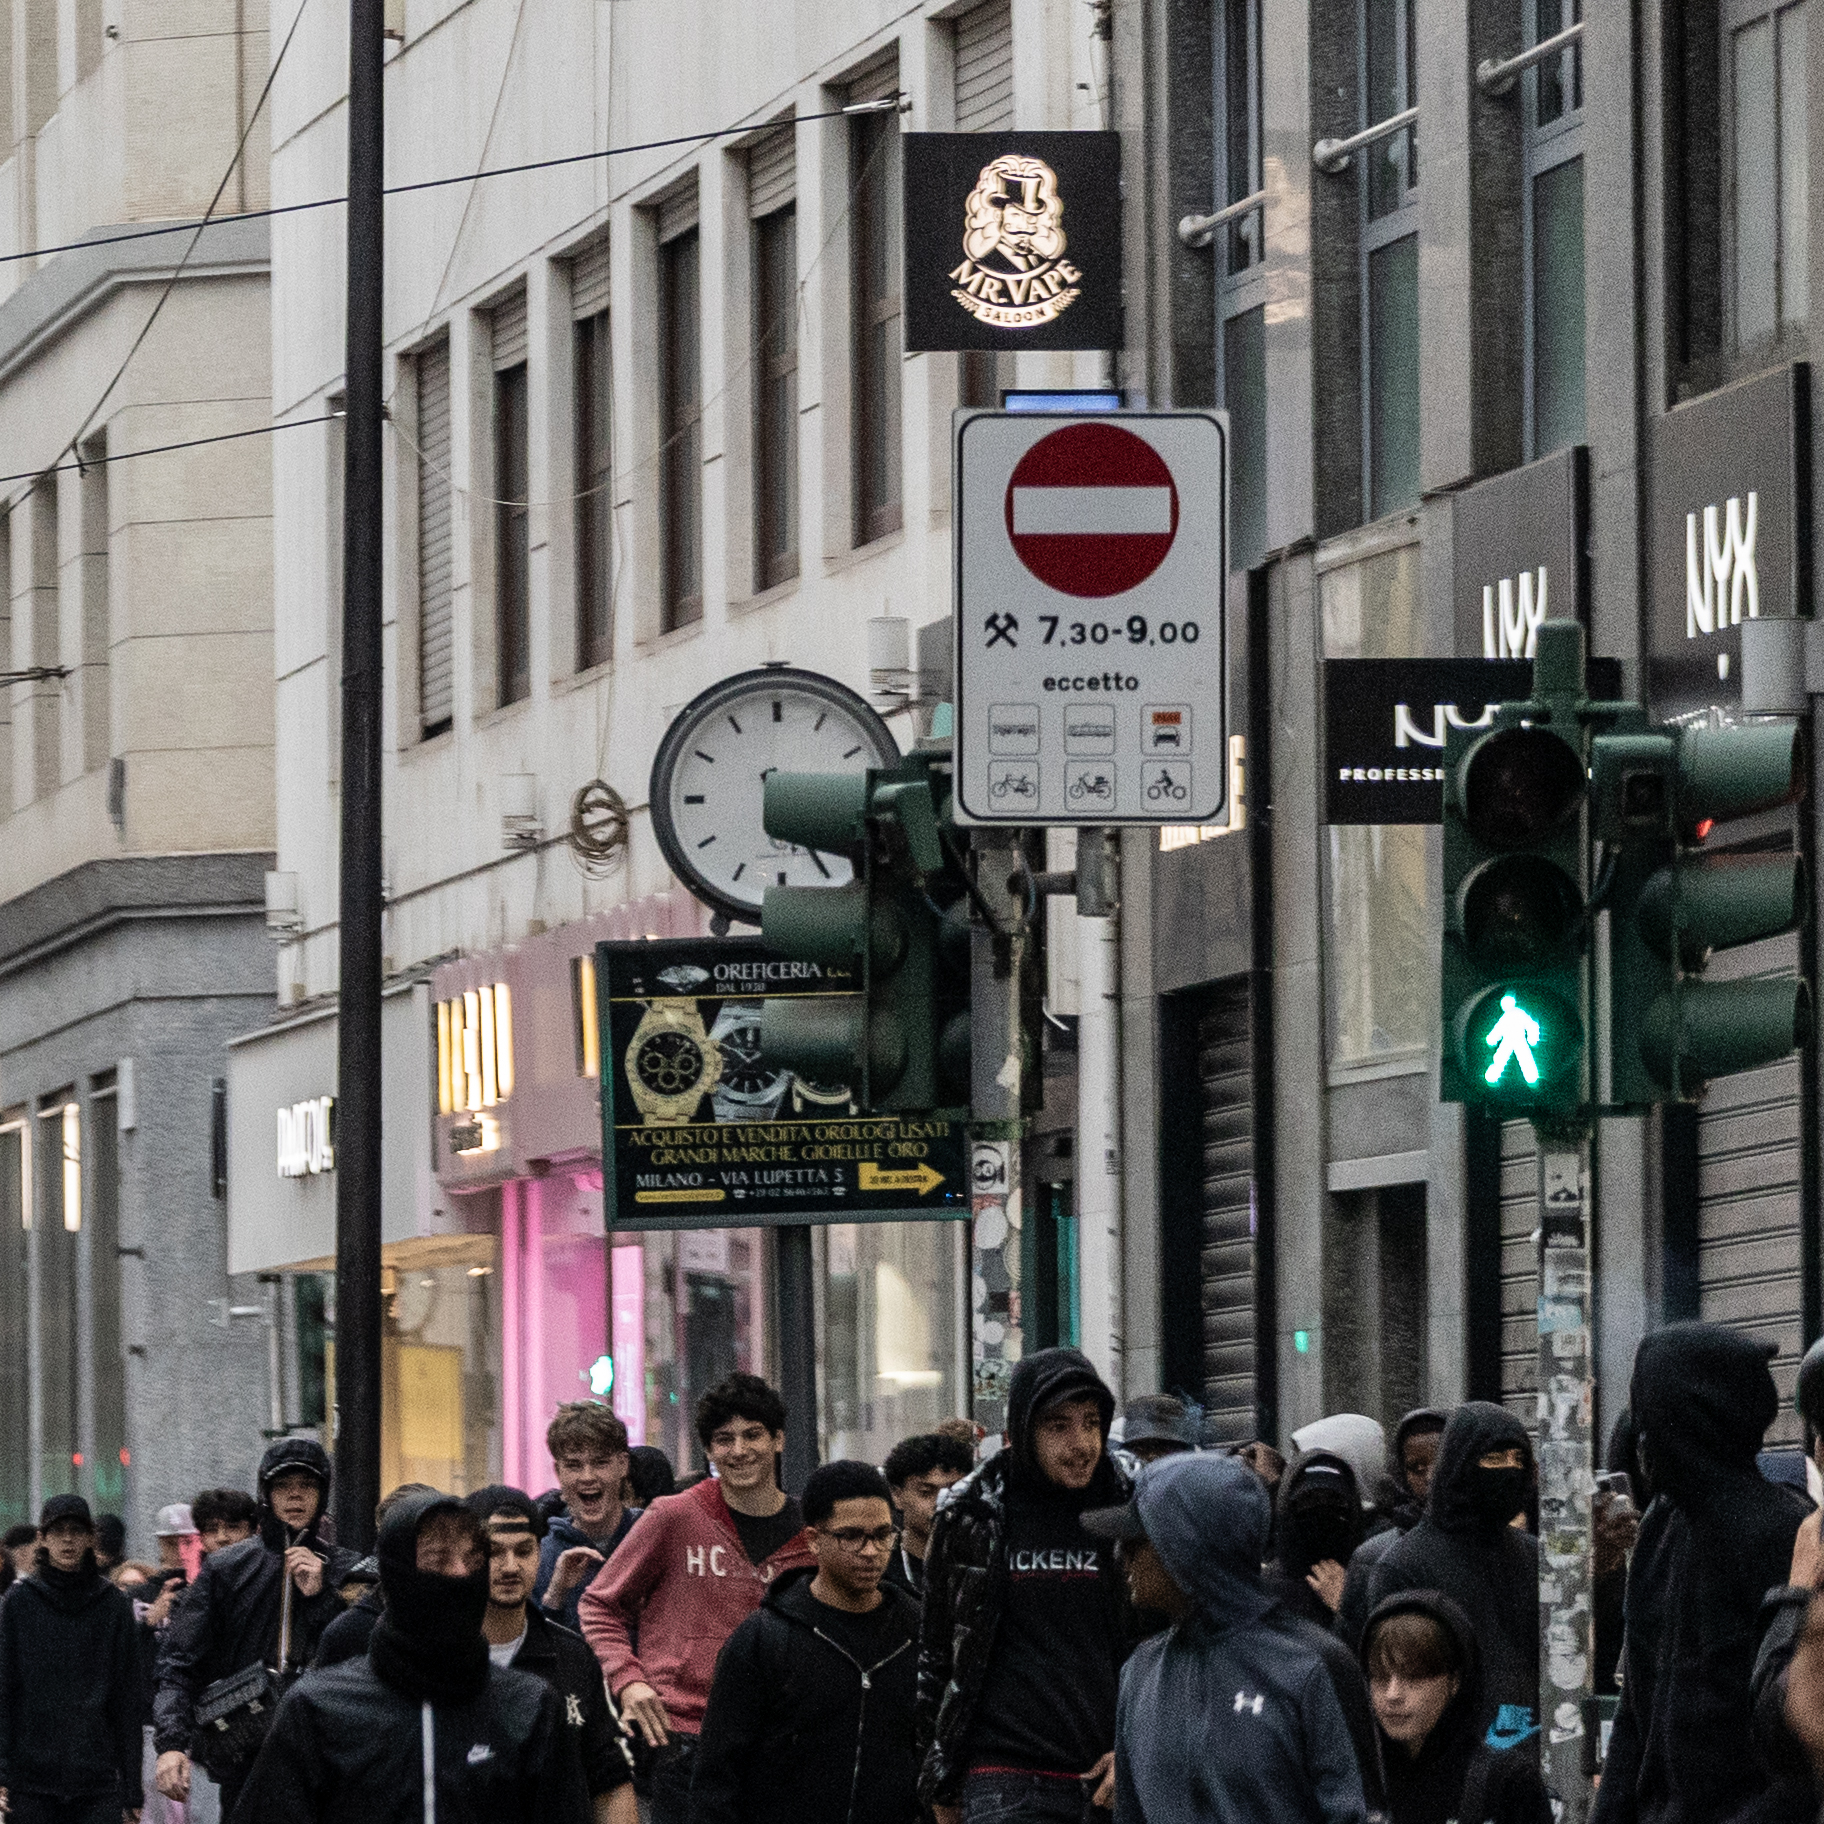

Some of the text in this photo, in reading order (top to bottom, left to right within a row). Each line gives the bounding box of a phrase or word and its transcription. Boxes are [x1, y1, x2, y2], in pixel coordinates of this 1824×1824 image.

[1042, 672, 1140, 692] eccetto
[713, 962, 822, 981] OREFICERIA
[628, 1128, 719, 1147] ACQUISTO
[887, 1140, 929, 1159] ORO
[636, 1172, 702, 1188] MILANO
[719, 1169, 750, 1185] VIA
[753, 1167, 830, 1185] LUPETTA
